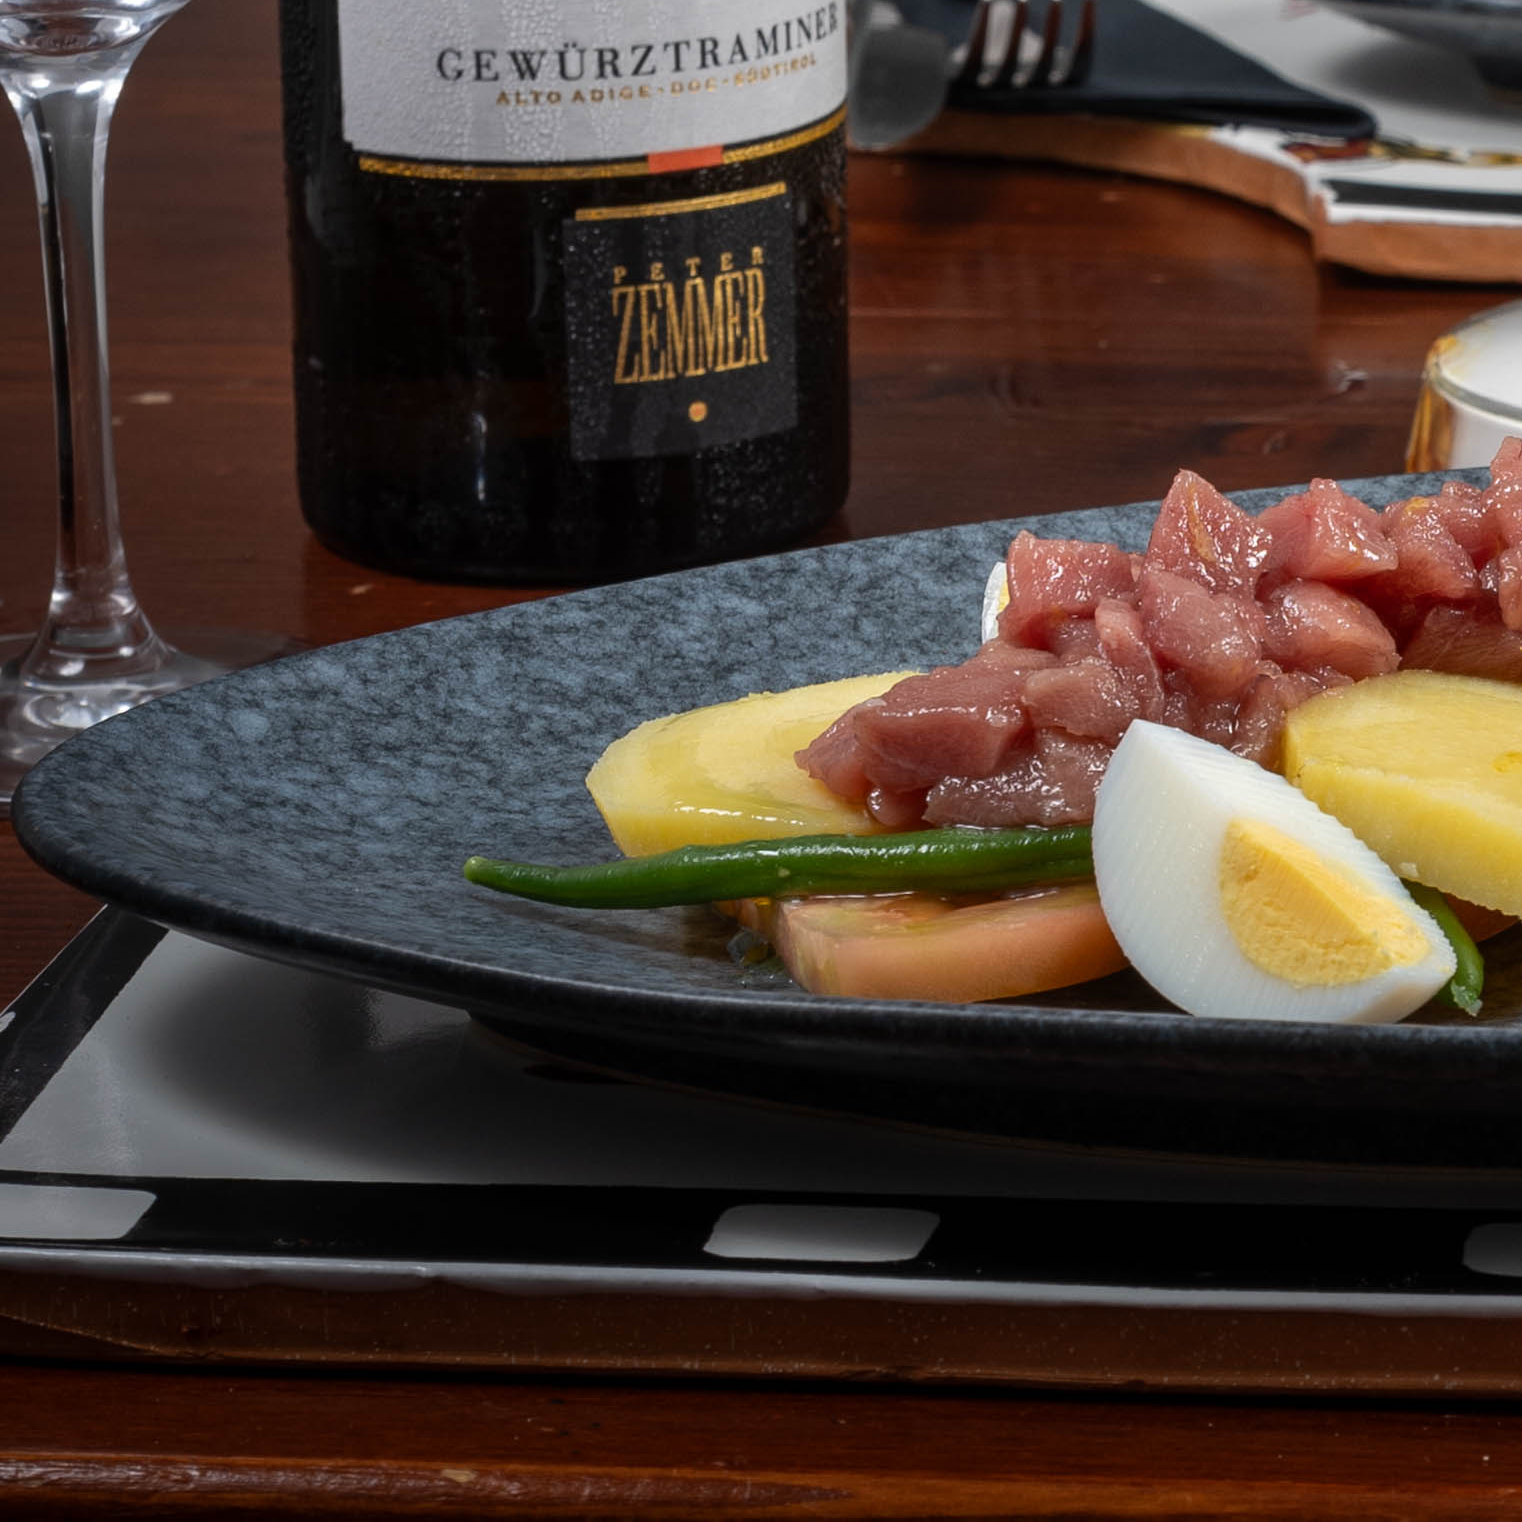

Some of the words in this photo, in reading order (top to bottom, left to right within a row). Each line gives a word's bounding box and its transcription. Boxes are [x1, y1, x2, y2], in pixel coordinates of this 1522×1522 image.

[437, 2, 838, 82] GEWÜRZTRAMINER
[495, 89, 563, 106] ALTO
[571, 84, 651, 104] ADIGE
[612, 246, 764, 284] PETER
[611, 268, 769, 384] ZEMMER
